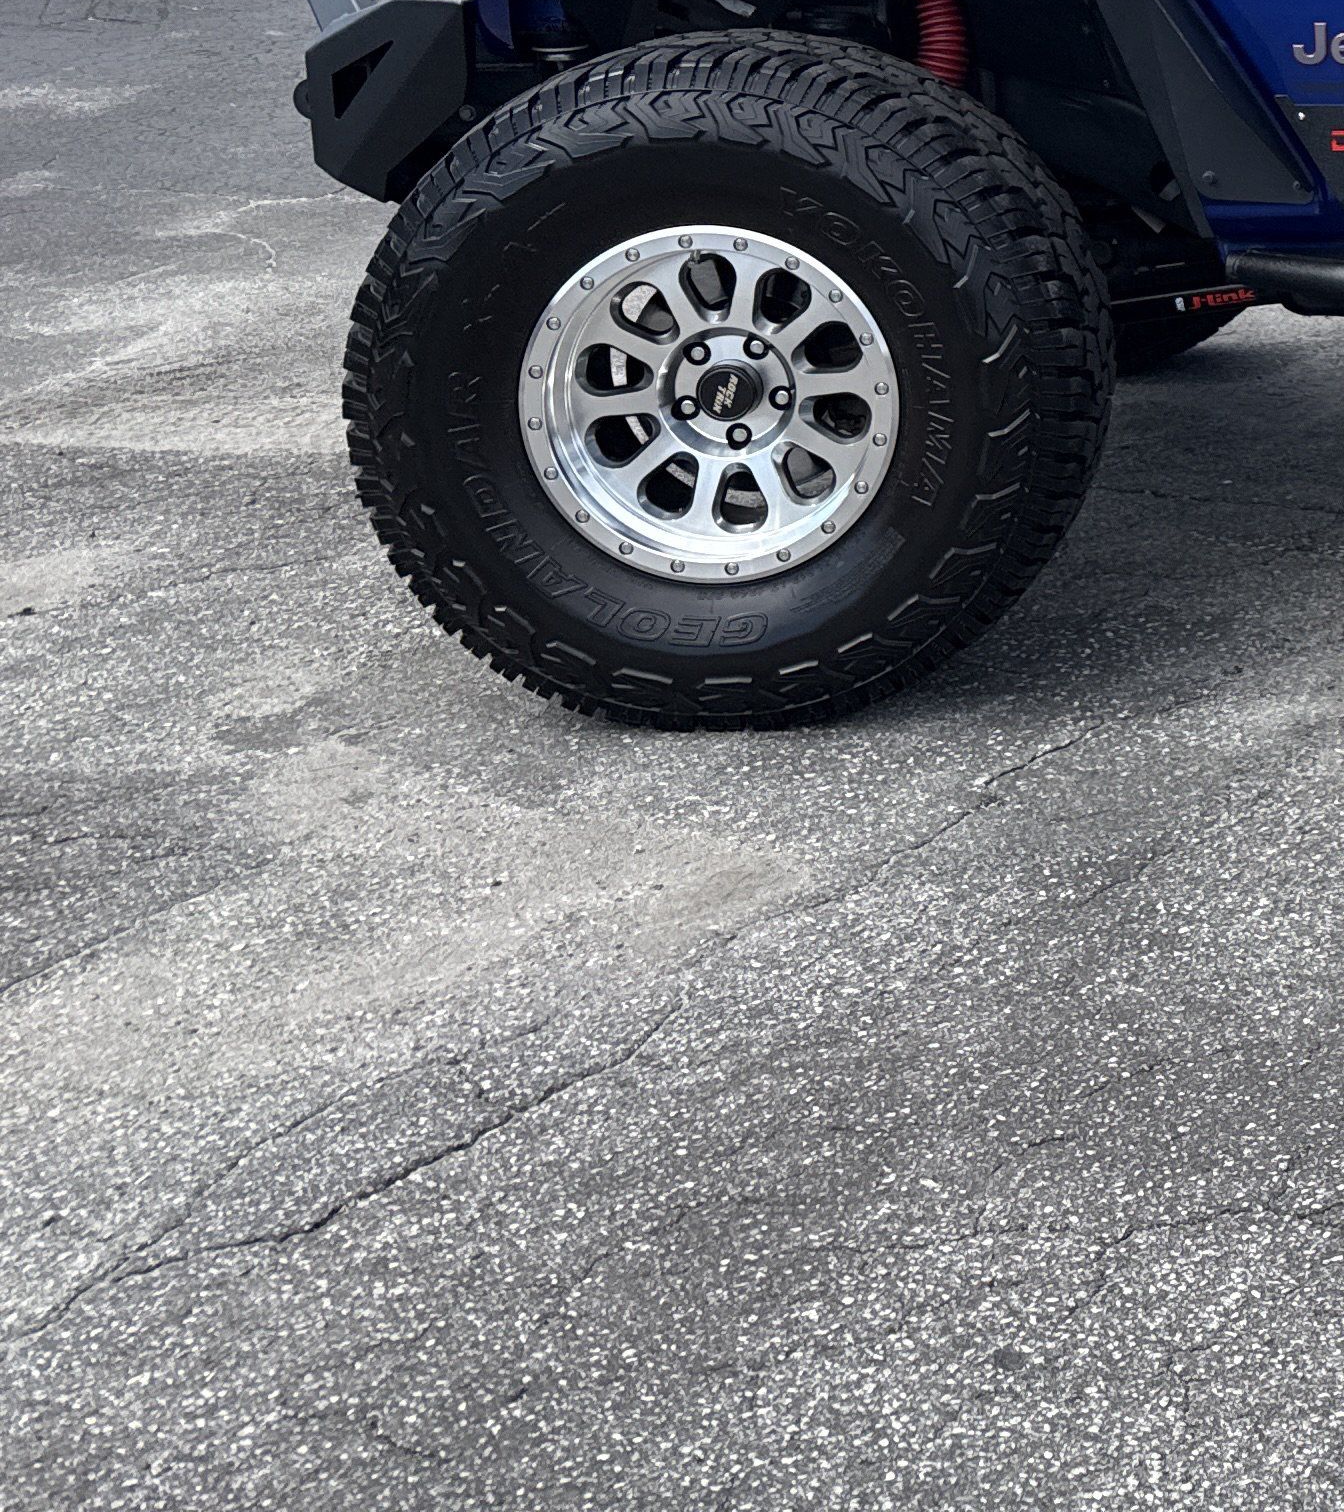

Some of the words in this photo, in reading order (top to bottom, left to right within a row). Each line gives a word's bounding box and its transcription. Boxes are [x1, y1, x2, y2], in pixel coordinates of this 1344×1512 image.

[723, 373, 739, 409] ROCK
[778, 186, 955, 510] YOKOHAMA
[446, 370, 769, 648] GEOLANDAR
